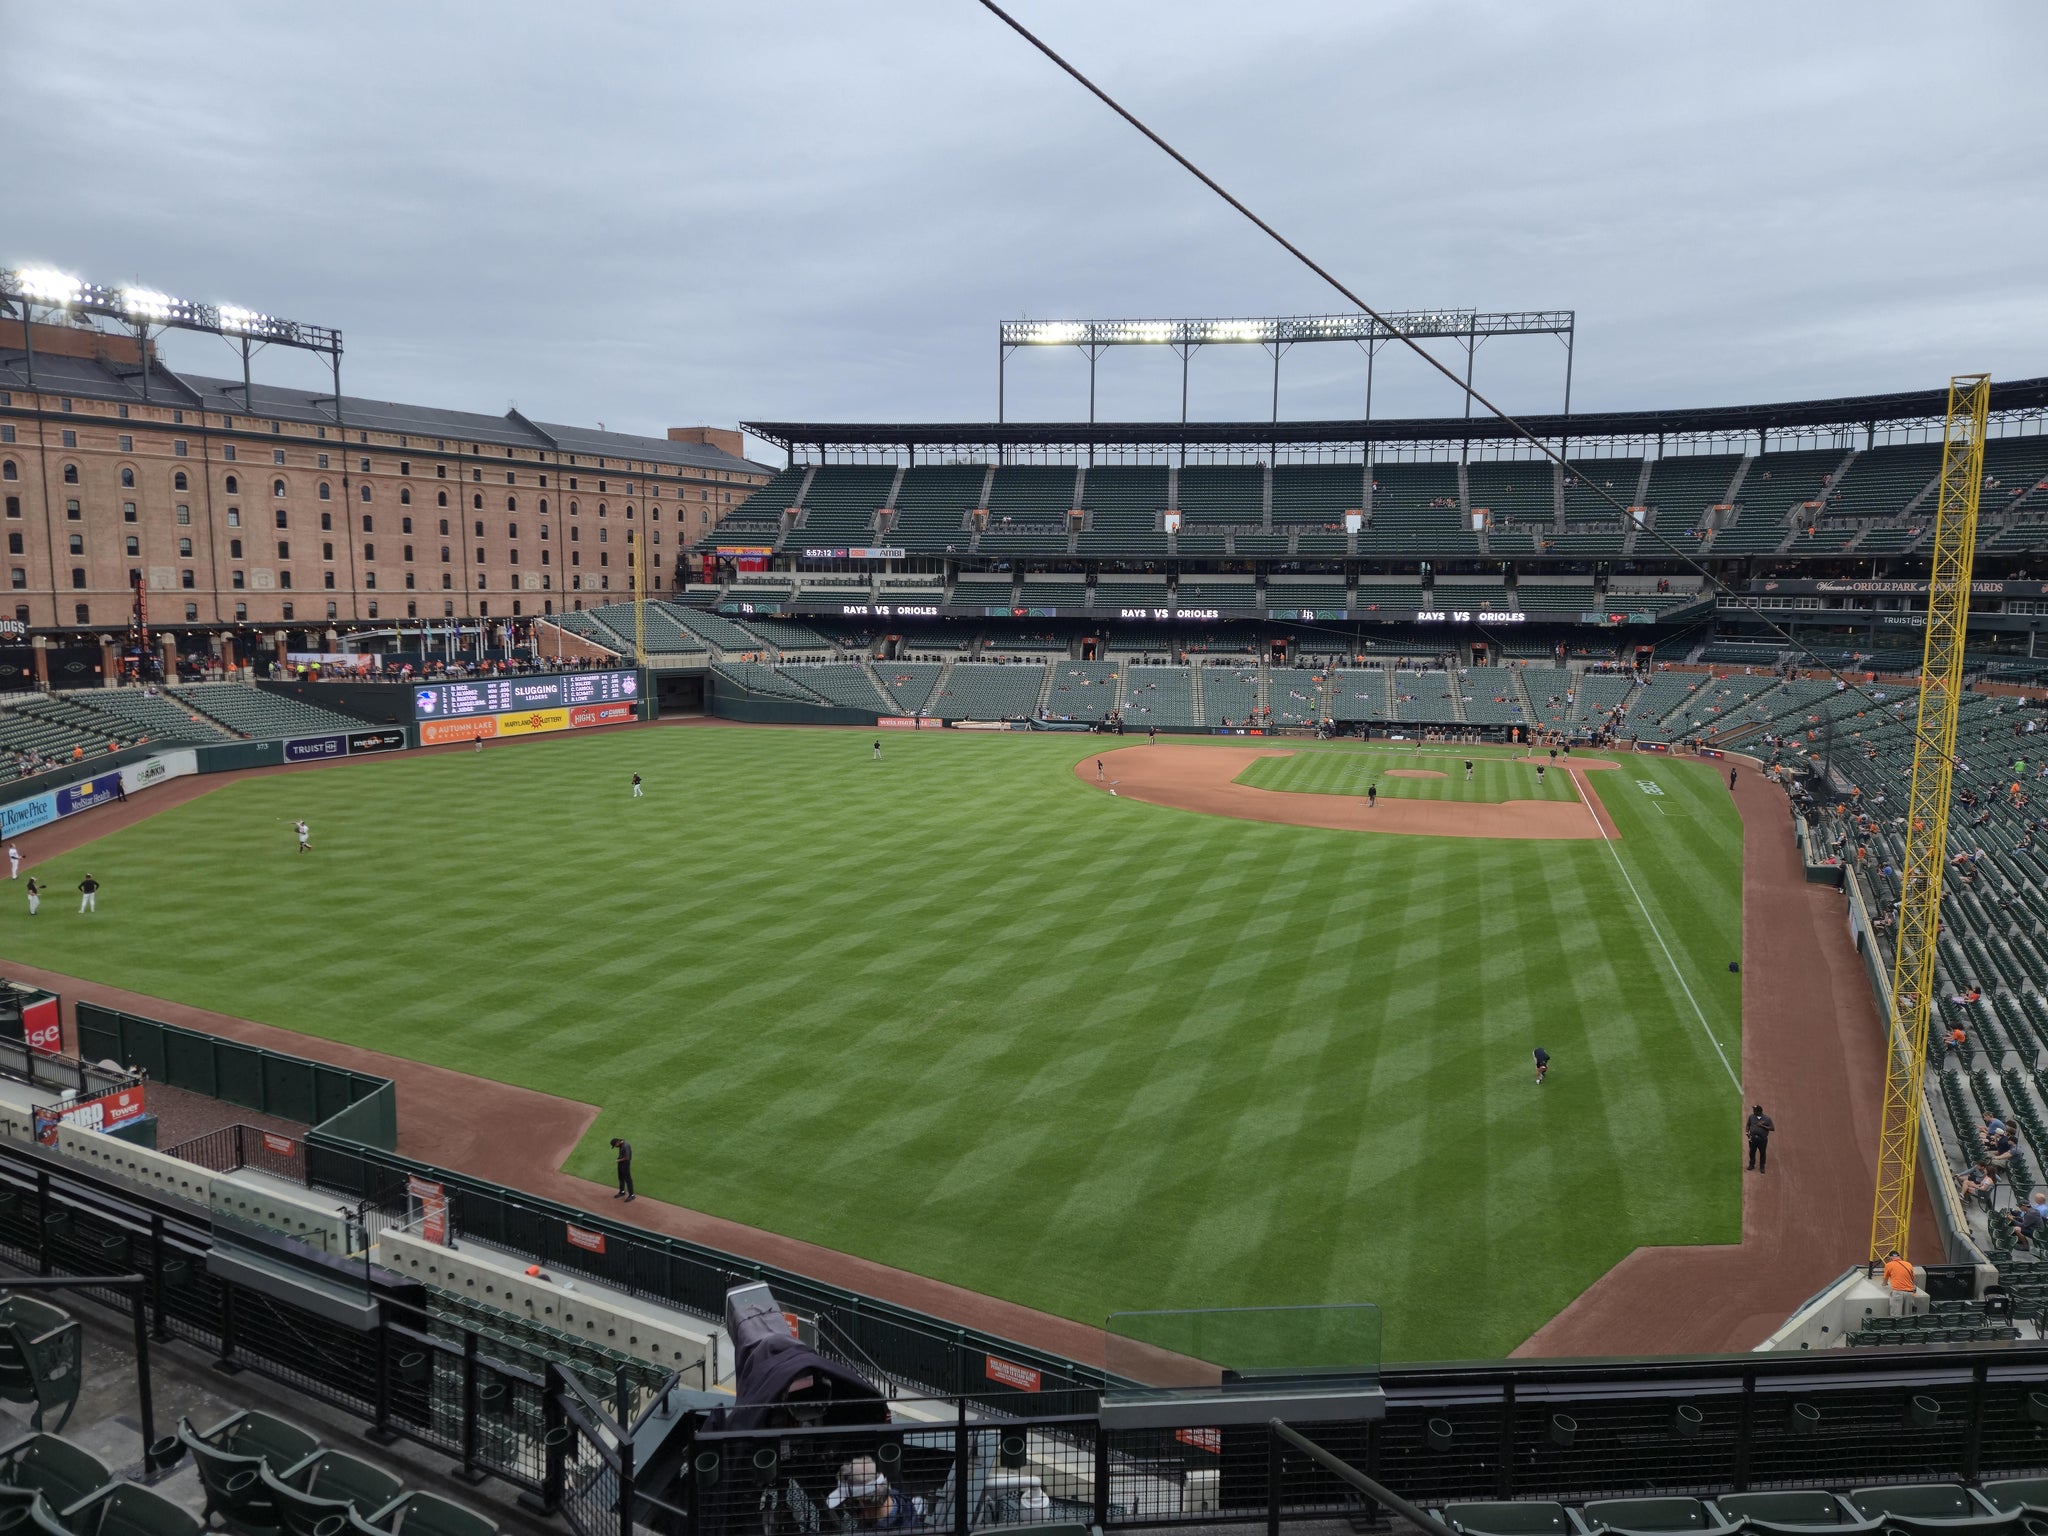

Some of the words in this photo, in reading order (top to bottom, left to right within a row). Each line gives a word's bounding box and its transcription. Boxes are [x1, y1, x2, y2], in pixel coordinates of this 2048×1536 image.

[1817, 581, 1845, 591] Welcome
[1853, 582, 1891, 591] ORIOLE
[1891, 582, 1918, 591] PARK
[1972, 582, 2004, 592] YARDS
[843, 605, 868, 614] RAYS
[875, 605, 890, 615] VS
[897, 606, 937, 615] ORIOLES
[1121, 609, 1146, 617] RAYS
[1154, 609, 1168, 618] VS
[1177, 610, 1218, 618] ORIOLES
[1418, 612, 1445, 620] RAYS
[1453, 612, 1470, 621] VS
[1479, 612, 1525, 621] ORIOLES
[1884, 616, 1911, 624] TRUIST
[514, 684, 558, 696] SLUGGING
[504, 719, 531, 728] MARYLAND
[574, 713, 596, 724] HIGH'S
[898, 718, 927, 726] marts
[438, 724, 471, 733] AUTUMN
[474, 721, 493, 730] LAKE
[293, 743, 324, 755] TRUIST
[72, 796, 94, 811] MedStar
[93, 789, 110, 804] Health
[7, 808, 30, 825] Rowe
[29, 801, 47, 817] Price
[62, 1103, 104, 1127] BIRD
[109, 1103, 139, 1118] Tower
